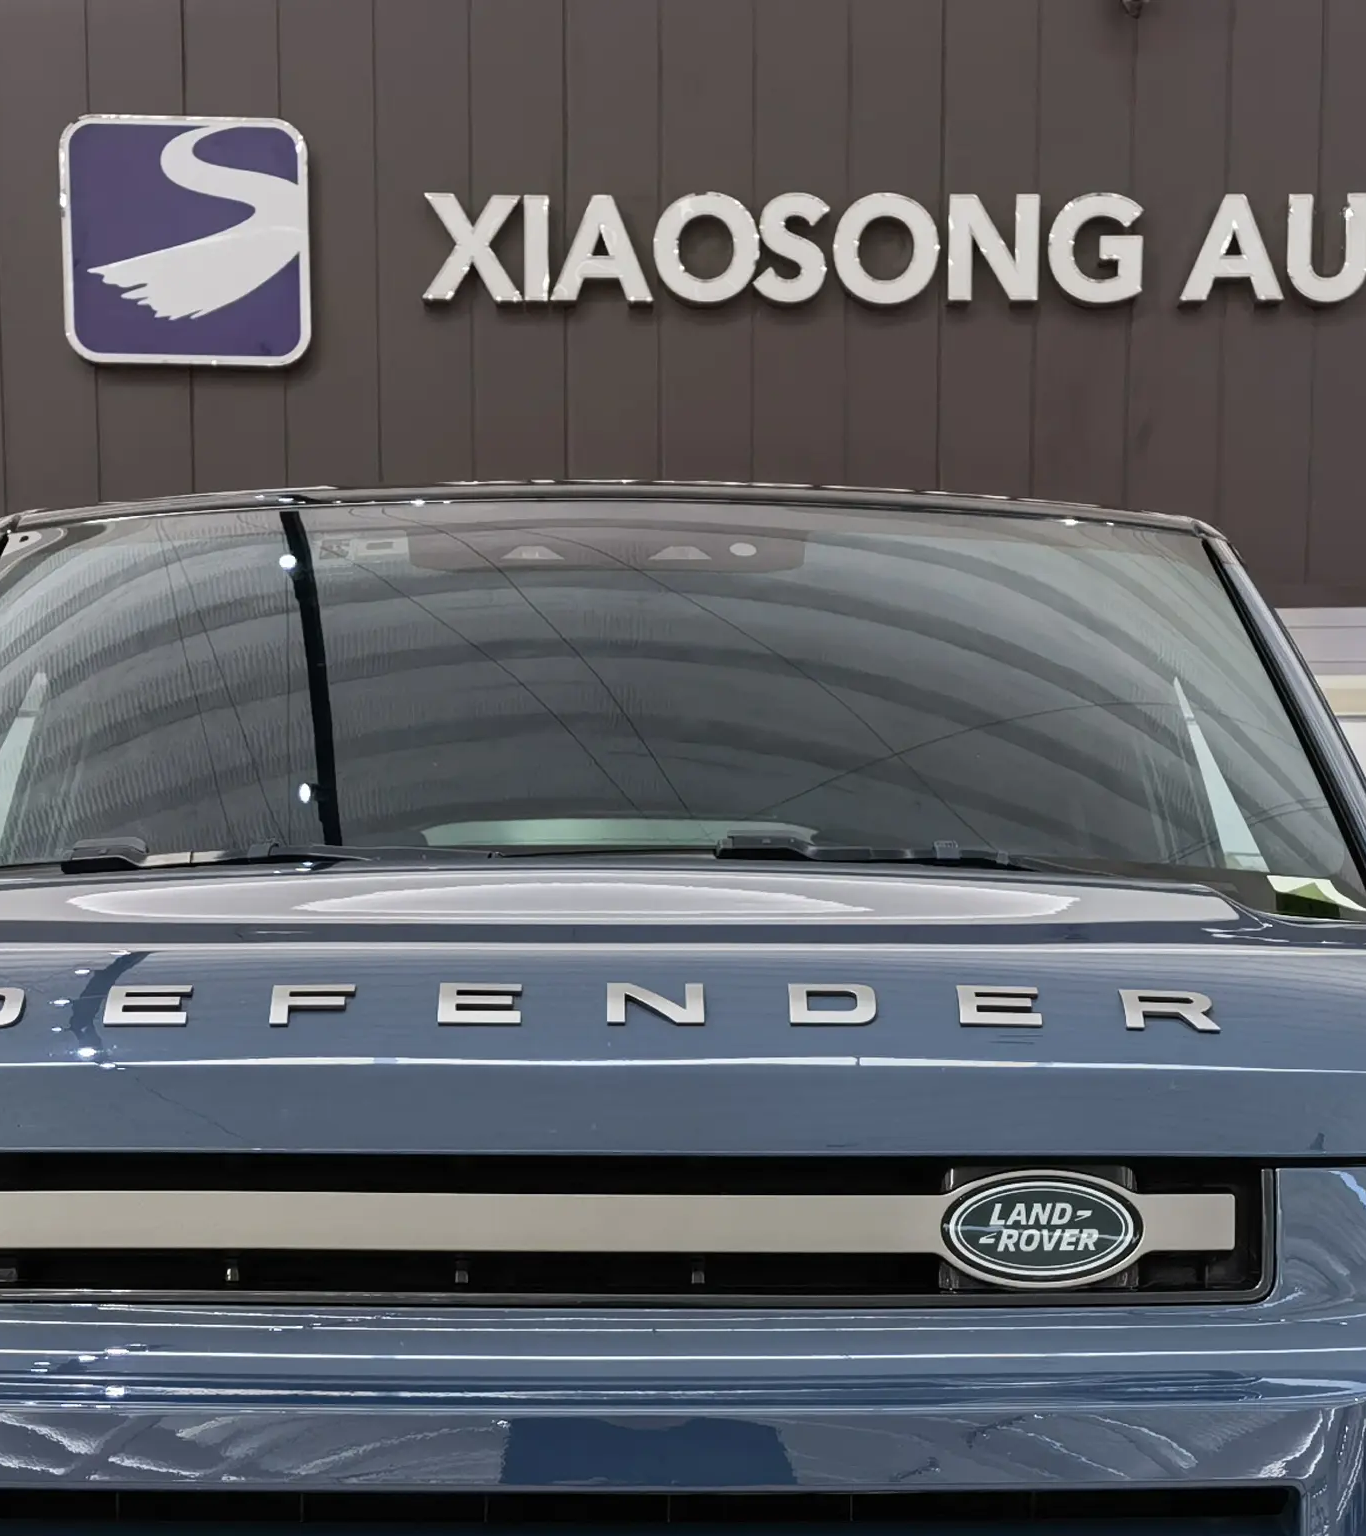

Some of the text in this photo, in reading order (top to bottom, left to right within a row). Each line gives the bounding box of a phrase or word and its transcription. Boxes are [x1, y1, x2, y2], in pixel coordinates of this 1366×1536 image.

[421, 190, 1145, 306] XIAOSONG
[989, 1202, 1073, 1226] LAND
[996, 1228, 1099, 1253] ROVER
